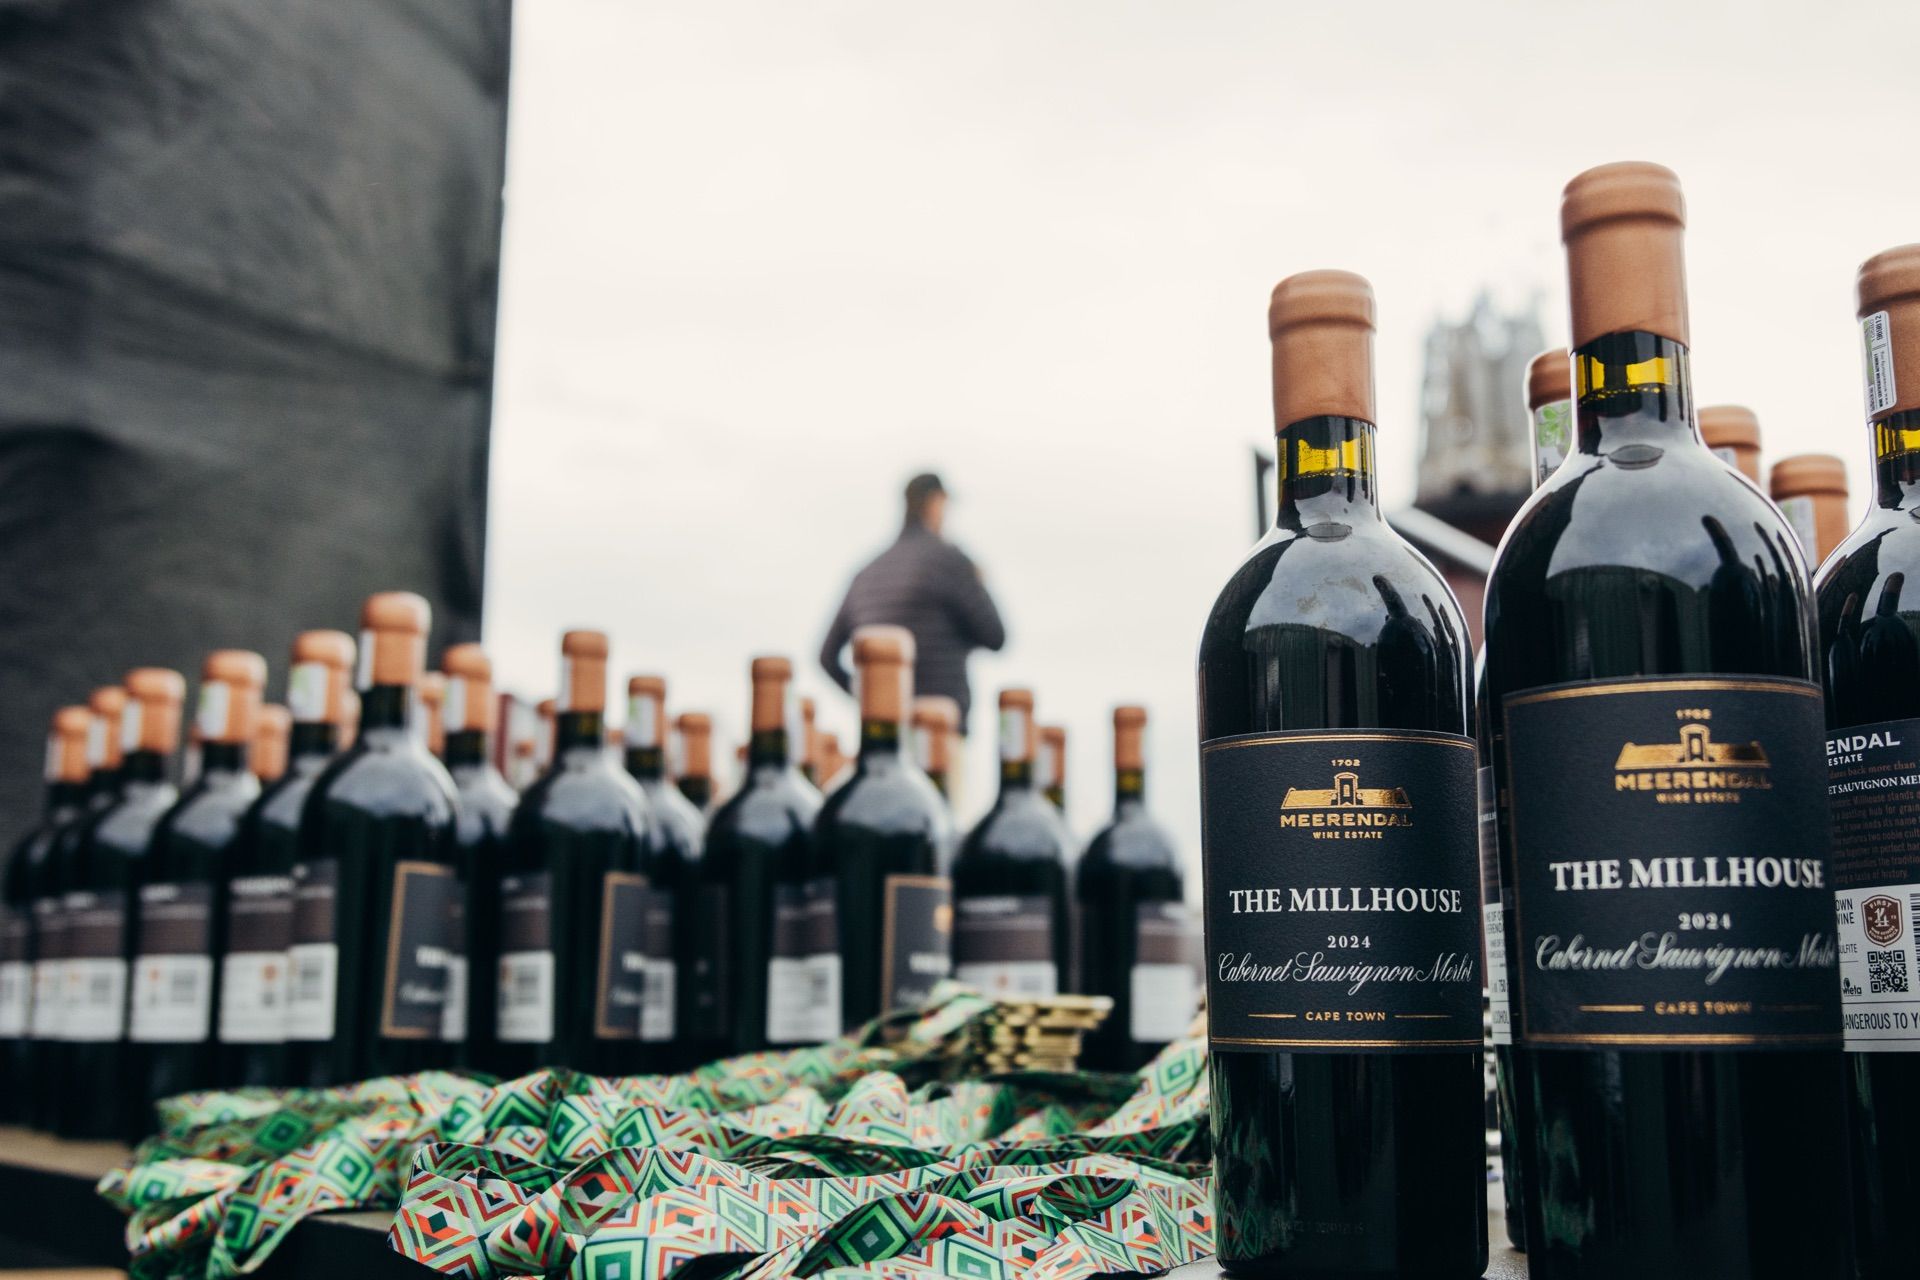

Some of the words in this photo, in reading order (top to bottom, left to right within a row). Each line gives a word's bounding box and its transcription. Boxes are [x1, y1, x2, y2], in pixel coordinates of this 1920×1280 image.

[1825, 731, 1901, 756] ENDAL
[1828, 753, 1863, 766] ESTATE
[1615, 771, 1773, 791] MEERENDAL
[1838, 777, 1899, 794] SAUVIGNON
[1280, 813, 1413, 828] MEERENDAL
[1313, 831, 1340, 839] WINE
[1345, 831, 1383, 839] ESTATE
[1549, 859, 1623, 892] THE
[1629, 857, 1826, 890] MILLHOUSE
[1229, 889, 1282, 914] THE
[1288, 887, 1462, 913] MILLHOUSE
[1869, 899, 1892, 909] FIRST
[1678, 912, 1732, 930] 2024
[1327, 935, 1371, 949] 2024
[1535, 934, 1639, 971] Cabernet
[1636, 931, 1783, 986] Sauvignon
[1218, 952, 1293, 983] Cabernet
[1292, 951, 1417, 996] Sauvignon
[1415, 952, 1473, 983] Merlot
[1305, 1011, 1340, 1021] CAPE
[1346, 1011, 1386, 1021] TOWN
[1654, 1001, 1698, 1015] CAPE
[1703, 1001, 1752, 1015] TOWN
[1893, 1012, 1908, 1029] TO
[1911, 1012, 1920, 1029] Y
